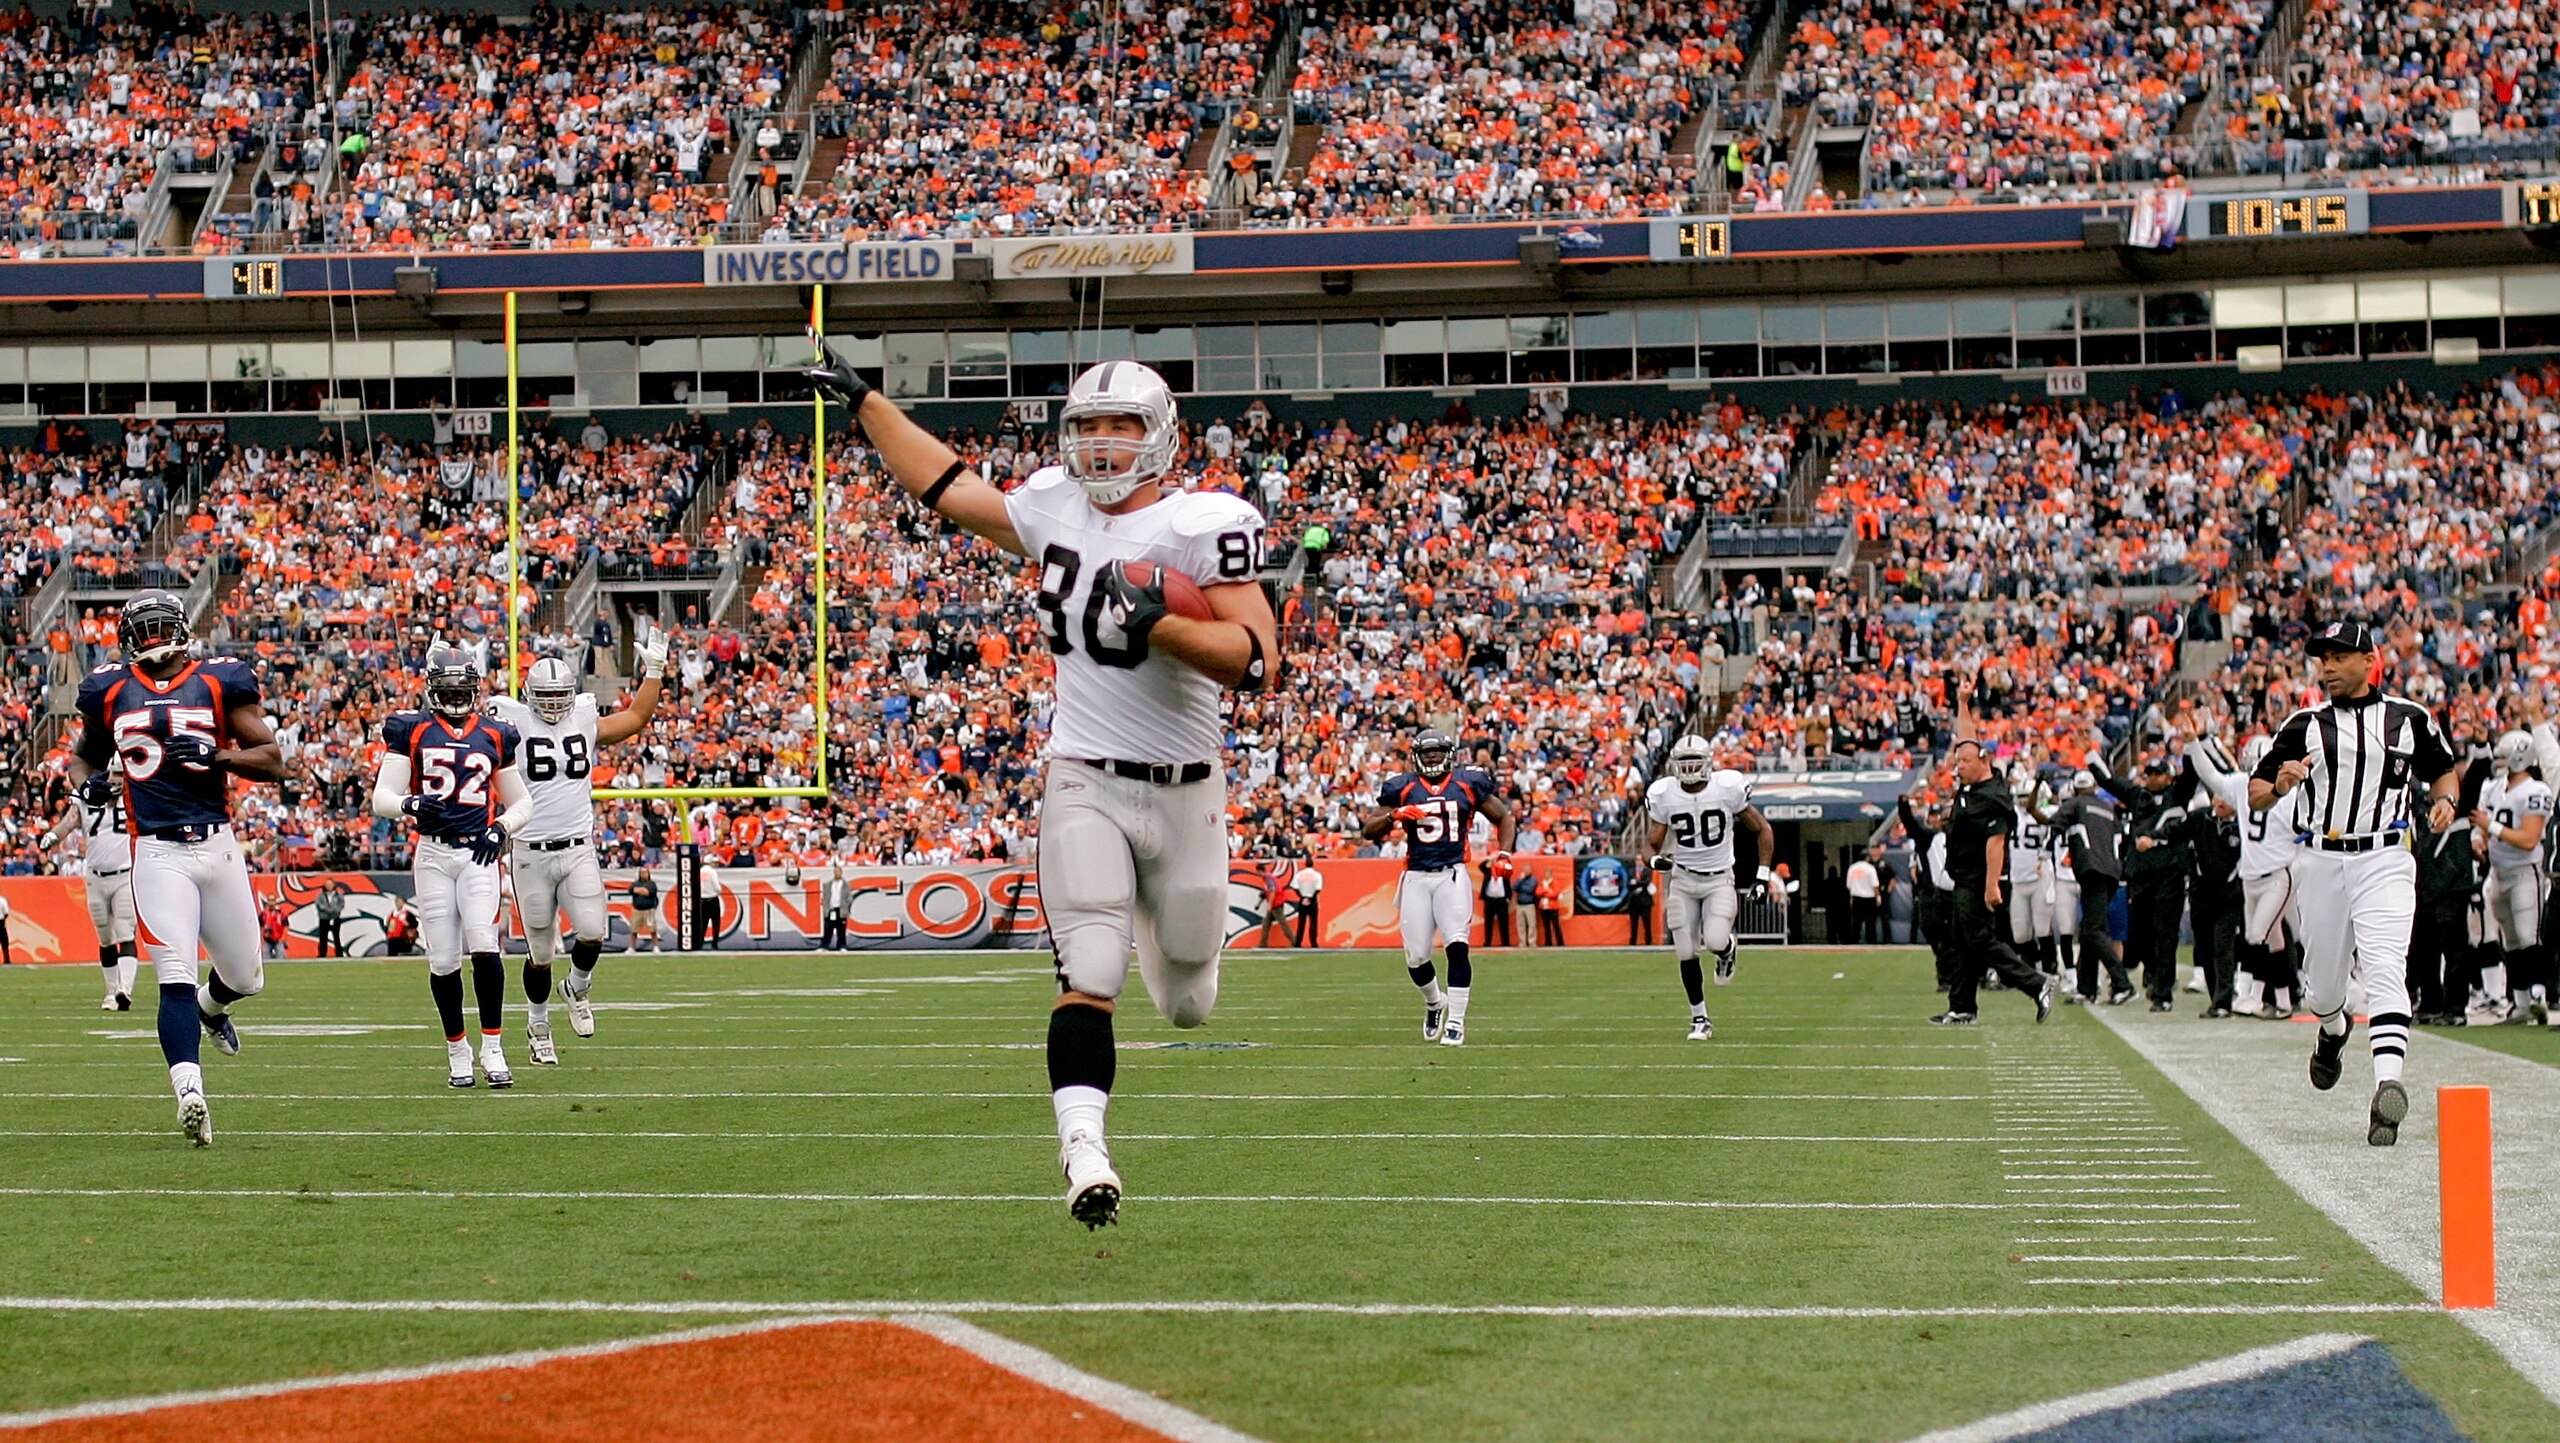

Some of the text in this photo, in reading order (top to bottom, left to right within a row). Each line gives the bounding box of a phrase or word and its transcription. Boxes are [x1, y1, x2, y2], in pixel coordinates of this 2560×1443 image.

[2226, 195, 2347, 238] 10:45
[1050, 239, 1112, 273] Mile
[1114, 236, 1177, 274] High
[1680, 223, 1725, 257] 40
[233, 262, 278, 295] 40
[716, 247, 941, 282] INVESCO FIELD
[2050, 375, 2082, 390] 116
[457, 415, 488, 431] 113
[1012, 402, 1044, 419] 114
[1217, 529, 1264, 578] 80
[1037, 543, 1150, 669] 80
[112, 706, 217, 782] 55
[526, 733, 590, 781] 68
[421, 747, 493, 806] 52
[1254, 758, 1269, 769] 24
[739, 822, 749, 836] 7
[1415, 800, 1460, 844] 51
[1671, 809, 1727, 848] 20
[1763, 805, 1823, 819] GEICO
[2248, 809, 2269, 842] 9
[681, 857, 692, 950] BRONCOS
